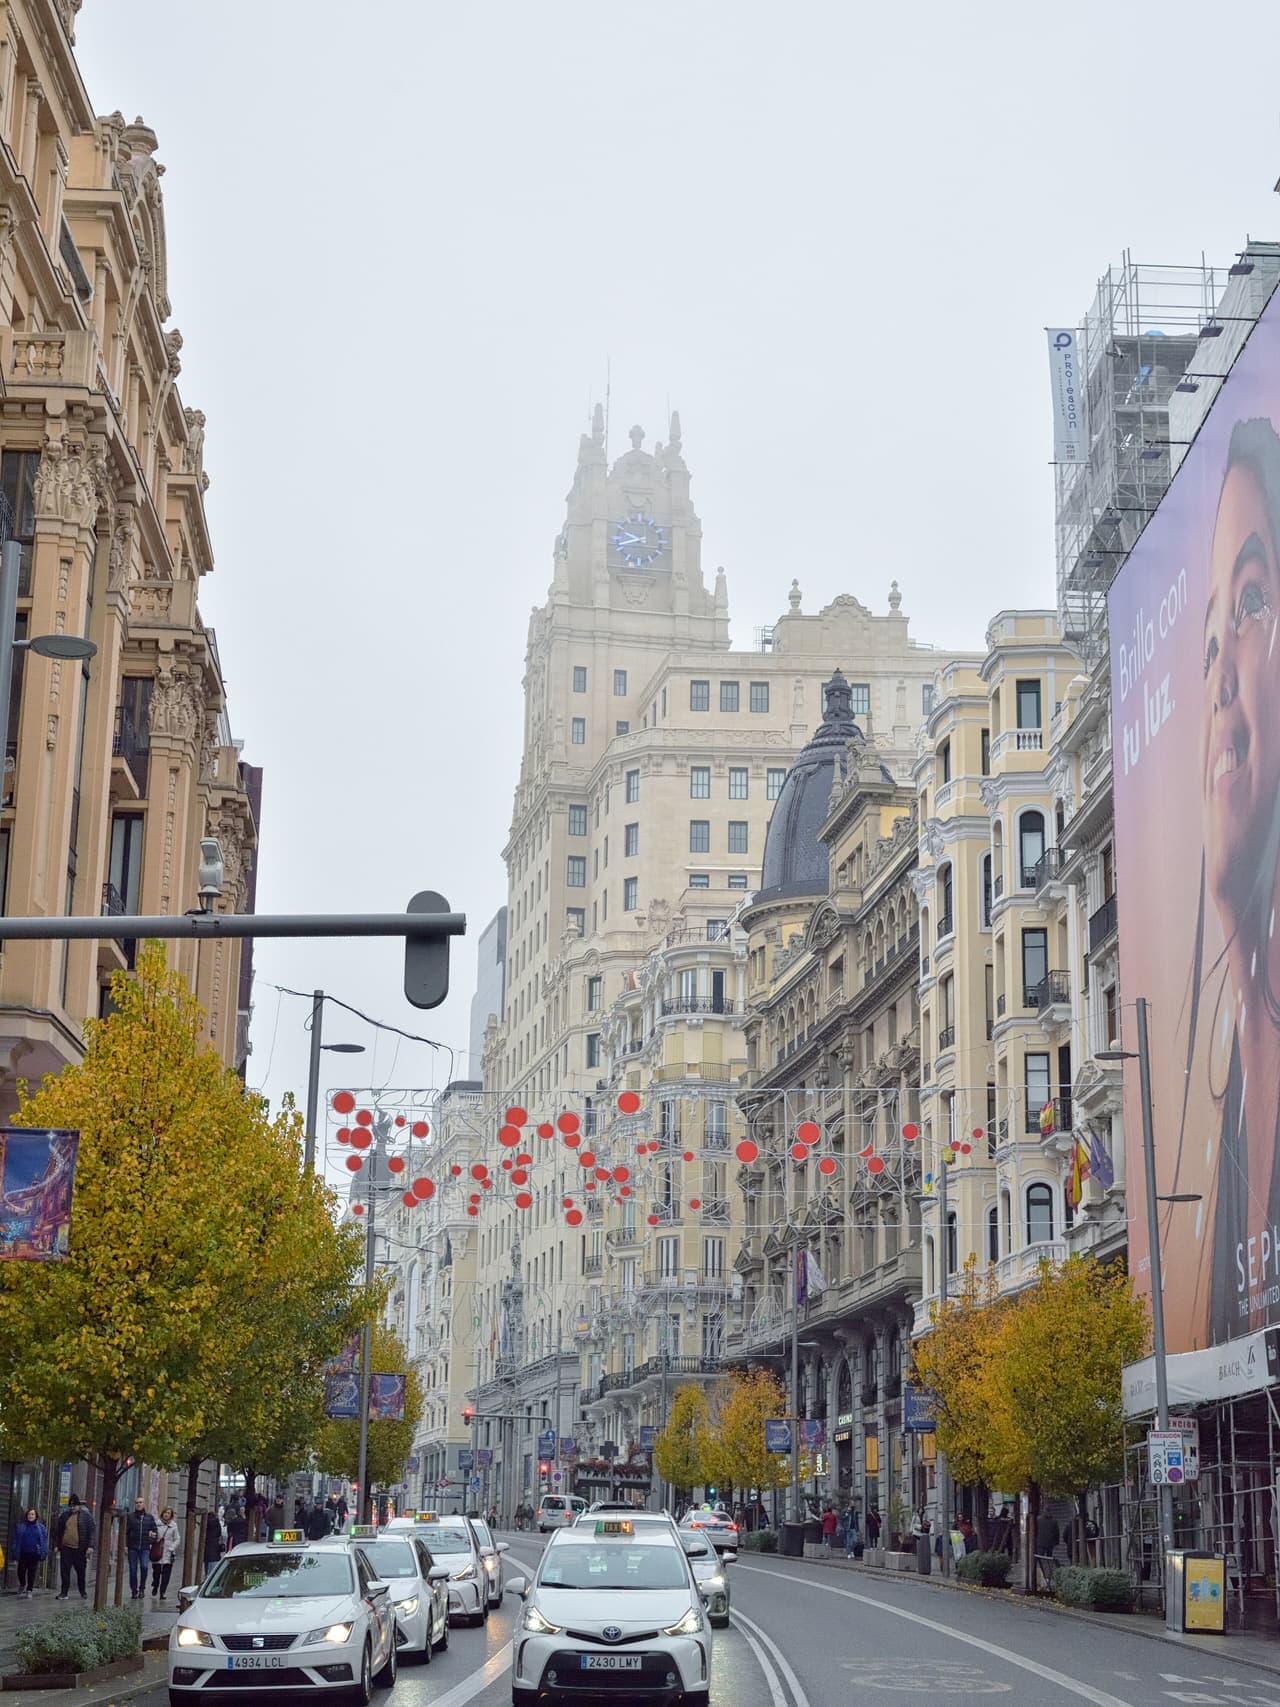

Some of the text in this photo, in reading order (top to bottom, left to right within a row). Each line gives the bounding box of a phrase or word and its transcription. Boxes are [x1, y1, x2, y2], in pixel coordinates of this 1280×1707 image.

[1119, 568, 1187, 703] Brilla con
[1123, 672, 1176, 776] tu luz.
[1238, 1298, 1249, 1317] THE
[605, 1521, 631, 1533] TAXI 4
[282, 1531, 297, 1542] TAXI
[235, 1657, 285, 1668] 4934 LCL
[589, 1657, 639, 1668] 2430 LMY
